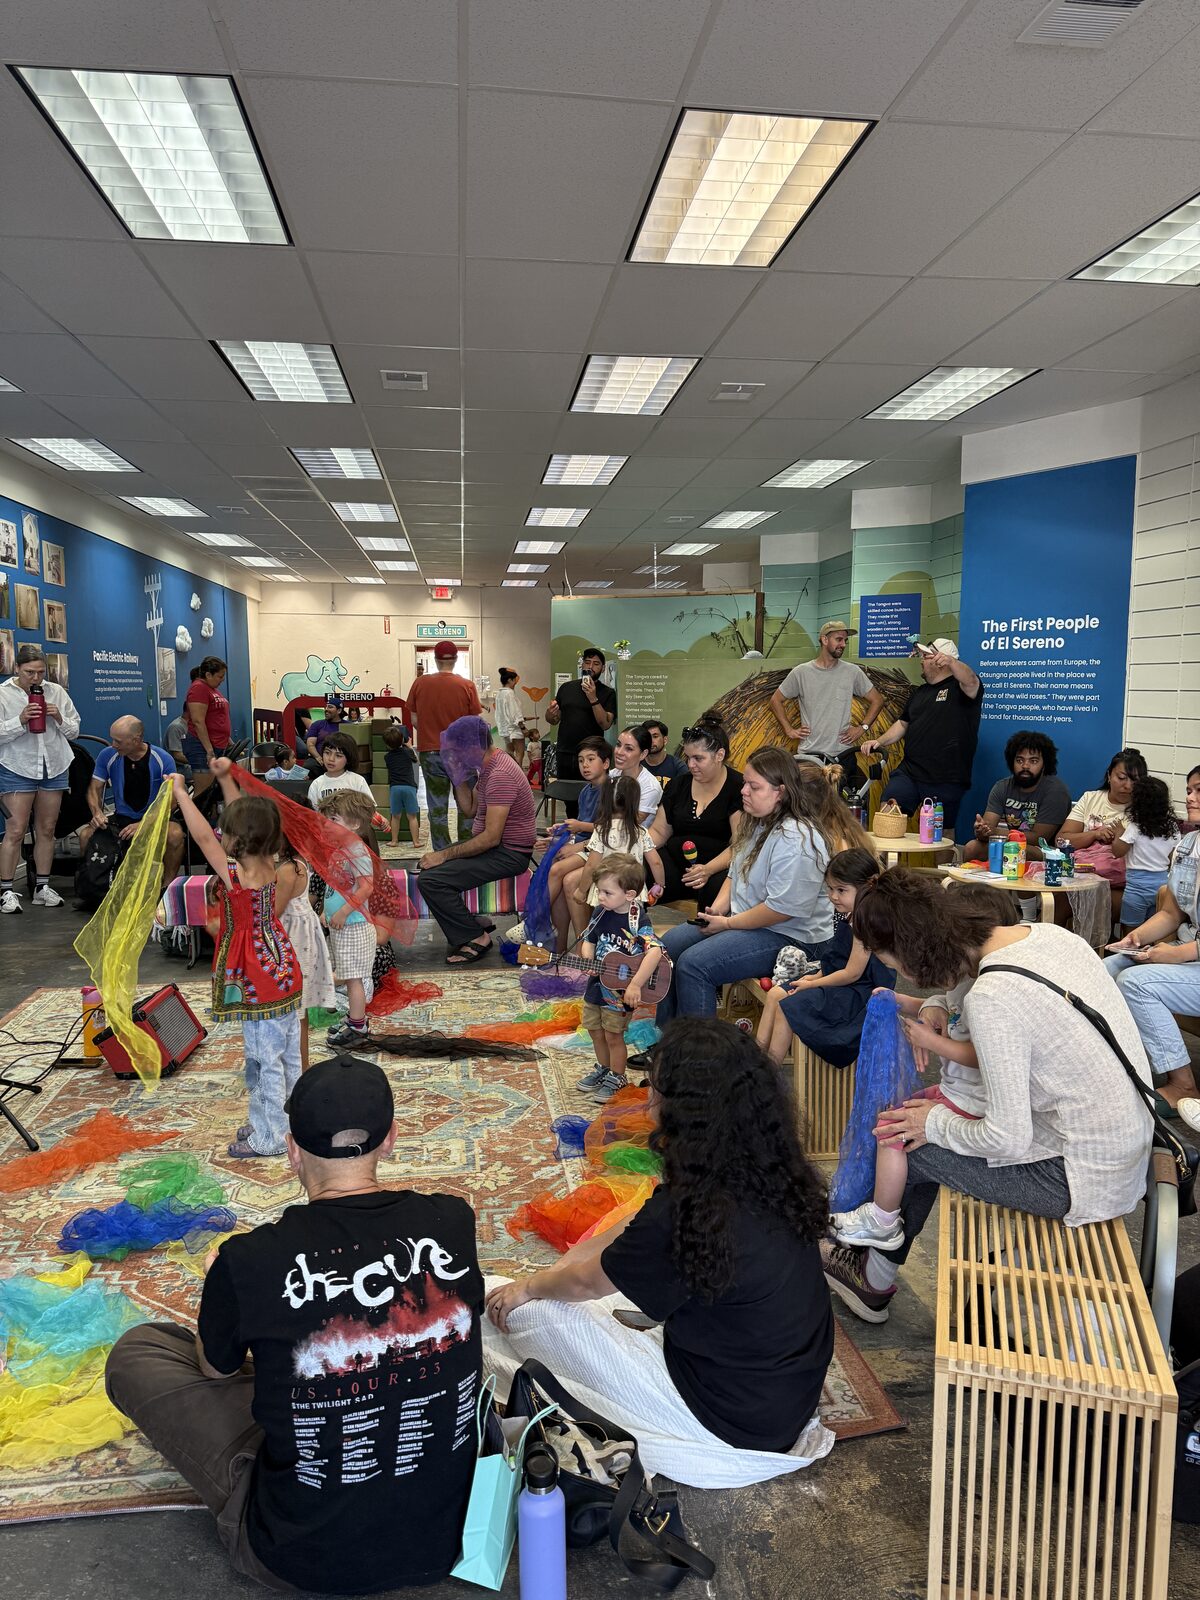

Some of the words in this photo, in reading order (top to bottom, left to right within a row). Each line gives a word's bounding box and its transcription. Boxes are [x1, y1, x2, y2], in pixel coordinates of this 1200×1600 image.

[982, 620, 1008, 632] The
[1011, 617, 1043, 632] First
[1046, 615, 1100, 633] People
[981, 636, 995, 650] of
[998, 636, 1010, 650] El
[1012, 636, 1064, 650] Sereno
[1064, 659, 1088, 667] Europe,
[312, 1398, 352, 1409] TWILIGHT
[354, 1393, 374, 1404] SAD
